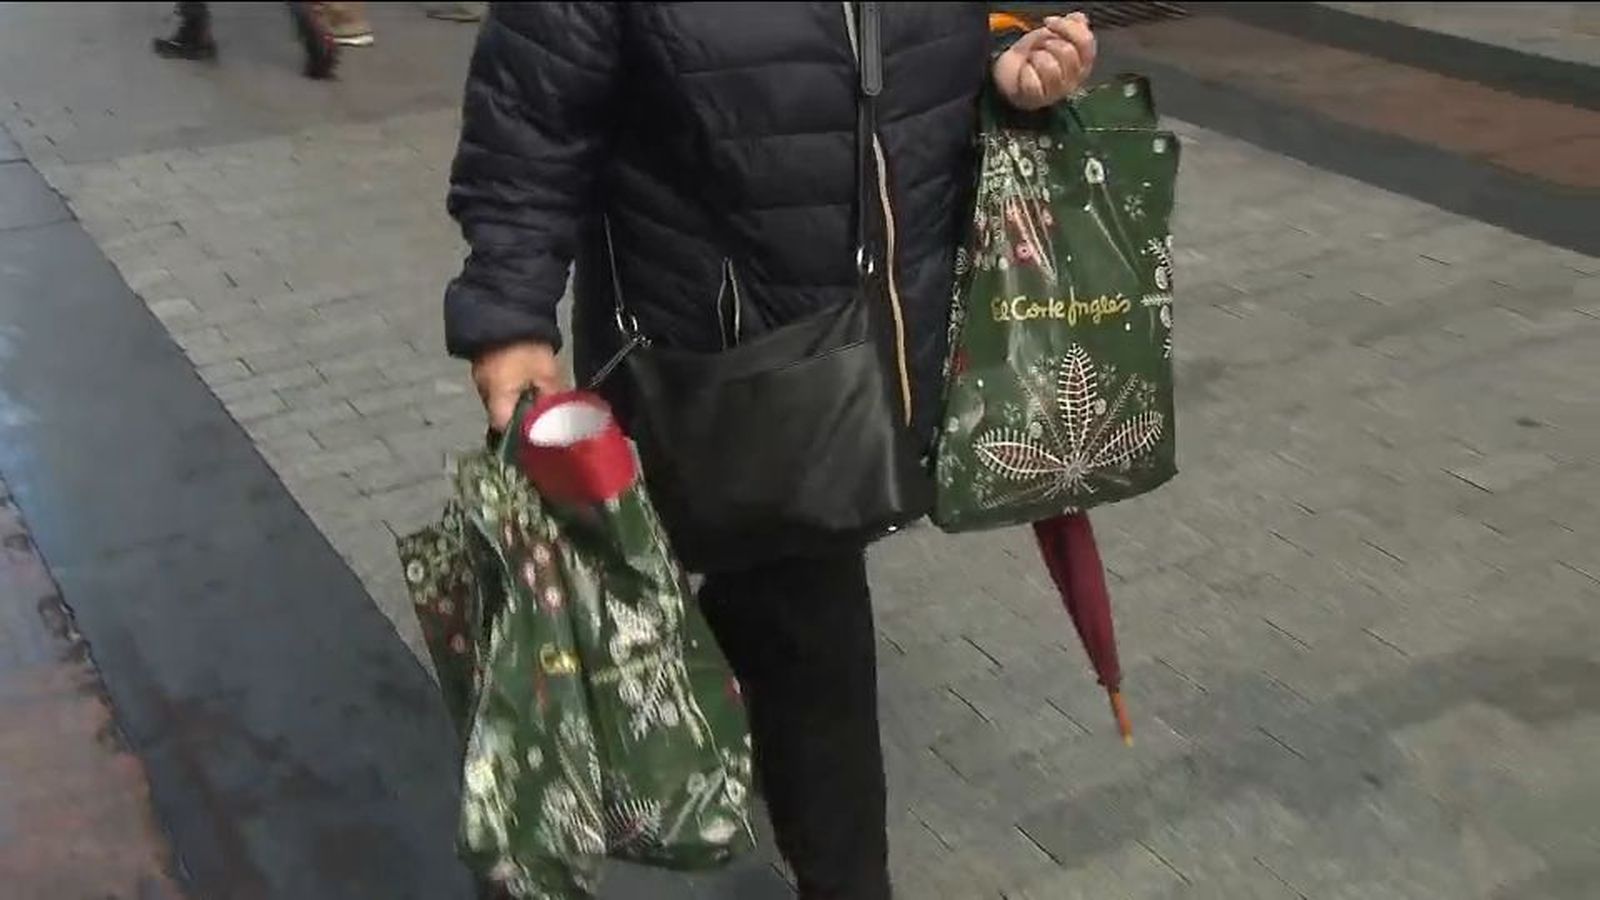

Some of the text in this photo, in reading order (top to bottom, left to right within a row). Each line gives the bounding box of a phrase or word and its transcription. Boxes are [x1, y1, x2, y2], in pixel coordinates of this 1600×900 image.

[990, 285, 1131, 327] El Corte Inglés
